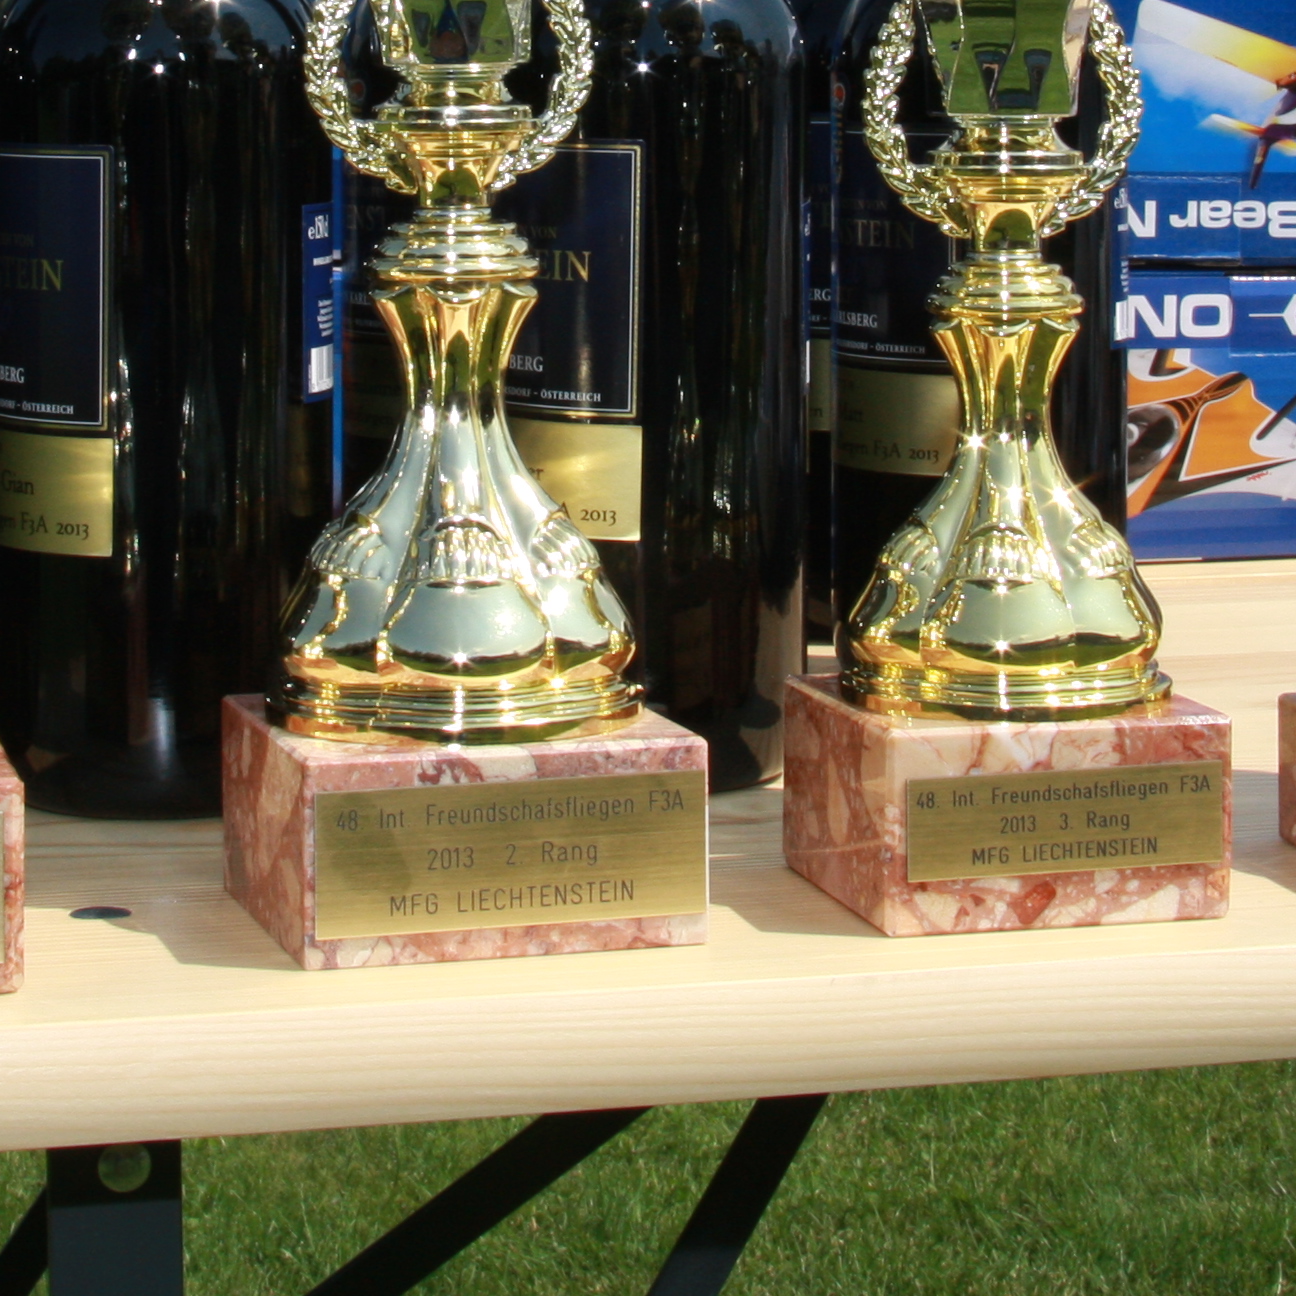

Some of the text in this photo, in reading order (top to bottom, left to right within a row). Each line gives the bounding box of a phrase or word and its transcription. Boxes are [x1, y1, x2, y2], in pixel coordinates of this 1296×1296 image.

[540, 388, 602, 403] ÖSTERREICH
[909, 448, 939, 464] 2013
[56, 522, 90, 541] 2013
[579, 509, 617, 527] 2013
[916, 775, 1211, 810] 48. Int. Freundschafsfliegen F3A
[336, 789, 684, 832] 48. Int. Freundschafsfliegen F3A
[1000, 811, 1131, 835] 2013 3. Rang
[427, 841, 598, 871] 2013 2. Rang
[971, 836, 1158, 866] MFG LIECHTENSTEIN
[389, 879, 634, 918] MFG LIECHTENSTEIN
